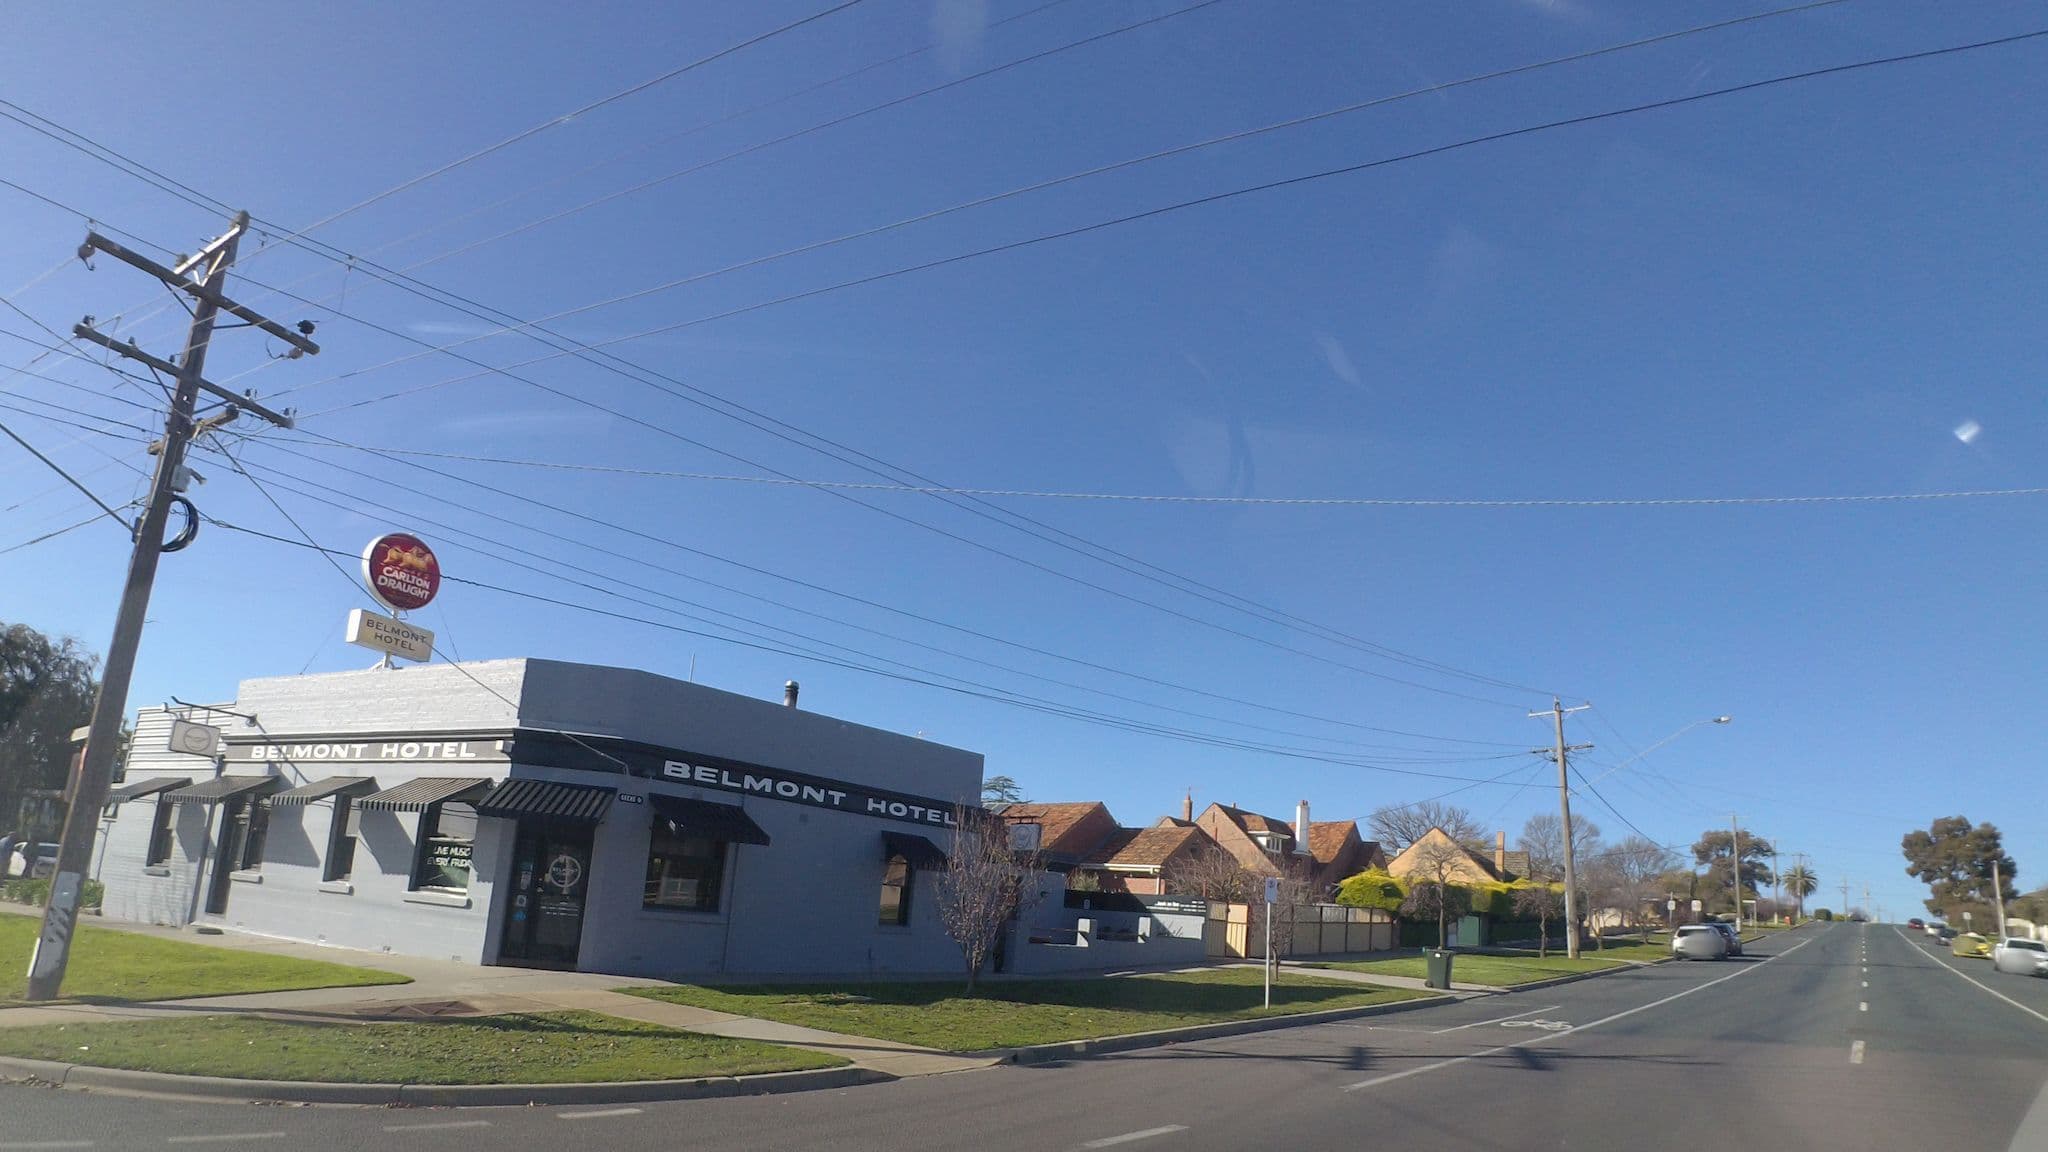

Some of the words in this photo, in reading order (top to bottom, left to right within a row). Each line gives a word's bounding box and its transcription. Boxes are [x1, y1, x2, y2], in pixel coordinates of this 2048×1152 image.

[377, 574, 430, 600] DRAUGHT
[382, 566, 431, 589] CARLTON
[366, 619, 427, 643] BELMONT
[374, 632, 416, 651] HOTEL
[251, 743, 368, 759] BELMONT
[381, 742, 476, 758] HOTEL
[663, 759, 847, 805] BELMONT
[866, 797, 959, 826] HOTEL
[450, 857, 473, 868] FRIDA
